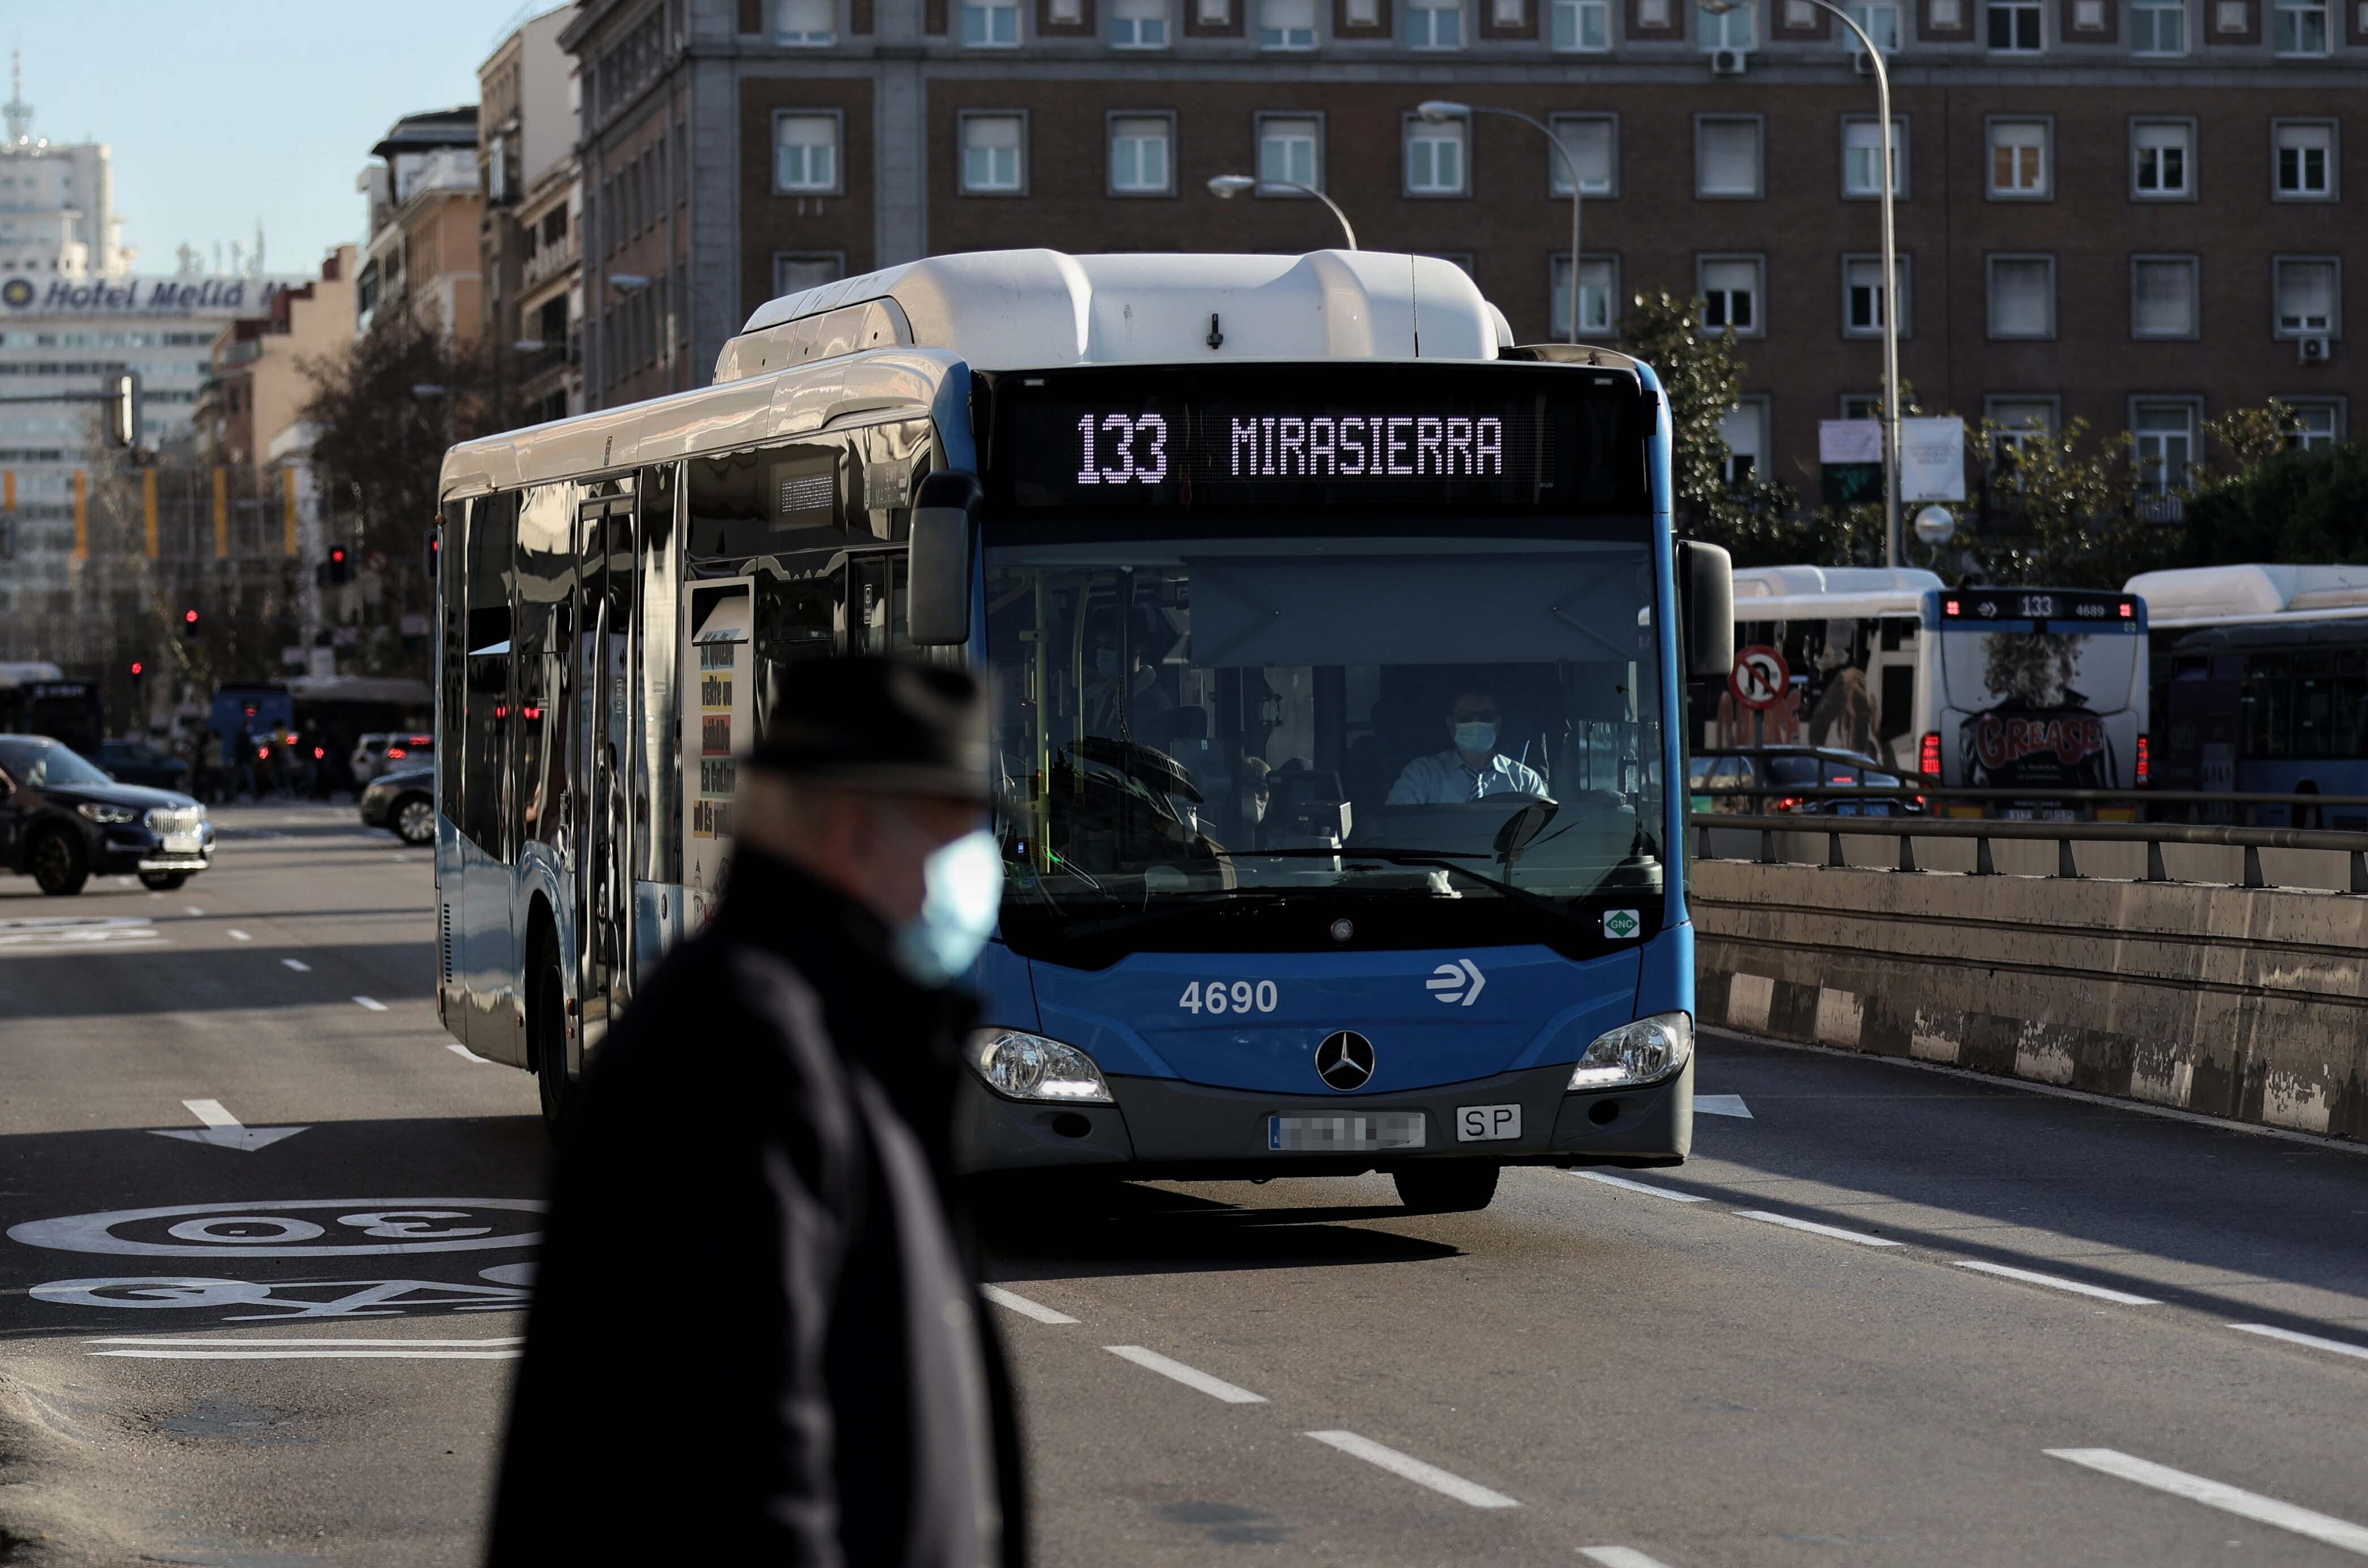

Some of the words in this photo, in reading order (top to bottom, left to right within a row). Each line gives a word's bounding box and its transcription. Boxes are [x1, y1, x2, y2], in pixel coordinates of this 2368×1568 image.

[45, 281, 138, 307] Hotel
[1078, 414, 1167, 484] 133
[1232, 418, 1503, 475] MIRASIERRA
[2021, 596, 2053, 617] 133
[1975, 714, 2103, 770] GREASE
[1611, 920, 1633, 929] GNC
[1179, 980, 1278, 1014] 4690
